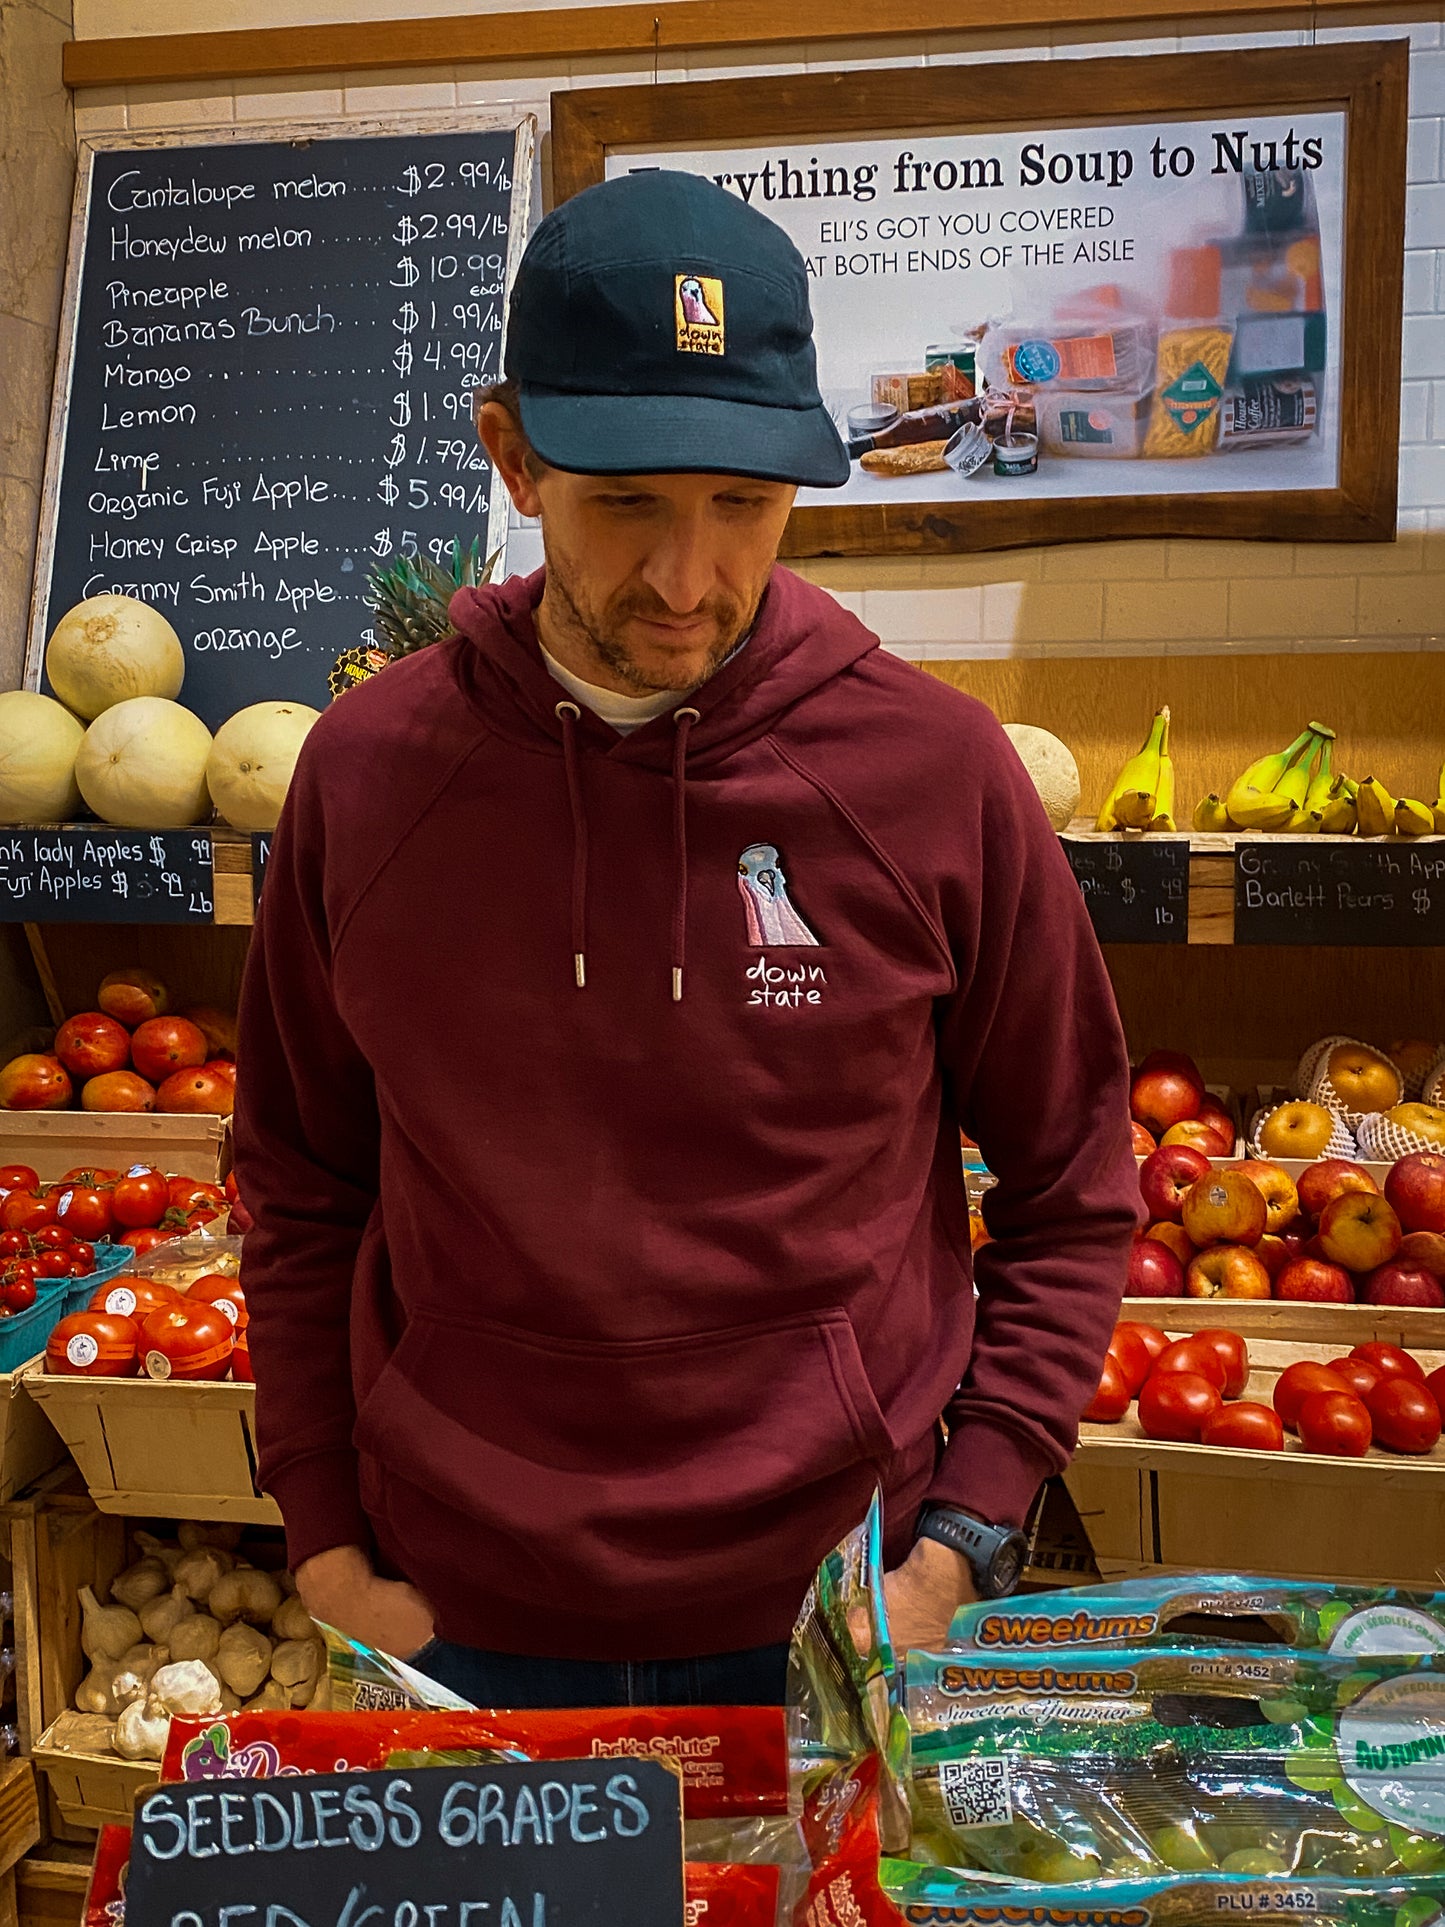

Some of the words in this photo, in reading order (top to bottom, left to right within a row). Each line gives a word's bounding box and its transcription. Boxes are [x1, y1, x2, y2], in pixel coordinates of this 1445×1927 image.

[628, 157, 878, 202] rything
[893, 151, 1004, 193] from
[1020, 143, 1133, 188] Soup
[1150, 137, 1195, 178] to
[1211, 128, 1323, 174] Nuts
[107, 170, 255, 212] Cantaloupe
[273, 174, 346, 200] melon
[111, 223, 227, 261] Honeydew
[239, 226, 312, 252] melon
[820, 220, 868, 243] ELI'S
[876, 216, 930, 240] GOT
[938, 211, 991, 236] YOU
[999, 206, 1115, 233] COVERED
[835, 252, 899, 277] BOTH
[908, 248, 972, 273] ENDS
[979, 246, 1013, 270] OF
[1022, 243, 1064, 266] THE
[1073, 239, 1135, 264] AISLE
[106, 278, 229, 309] Pineapple
[103, 318, 236, 348] Bananas
[241, 304, 335, 337] Bunch
[104, 363, 191, 389] Mango
[101, 402, 196, 430] Lemon
[202, 476, 242, 509] Fuji
[252, 473, 329, 510] Apple
[89, 531, 164, 562] Honey
[175, 532, 238, 559] Crisp
[254, 531, 320, 561] Apple
[190, 571, 265, 604] Smith
[275, 578, 335, 613] Apple
[34, 837, 74, 868] lady
[83, 839, 143, 868] Apples
[40, 865, 103, 900] Apples
[745, 955, 828, 984] down
[746, 983, 822, 1009] state
[141, 1778, 422, 1860] SEEDLESS
[438, 1774, 650, 1847] GRAPES
[1217, 1894, 1253, 1910] PLU
[1274, 1892, 1316, 1909] 3452
